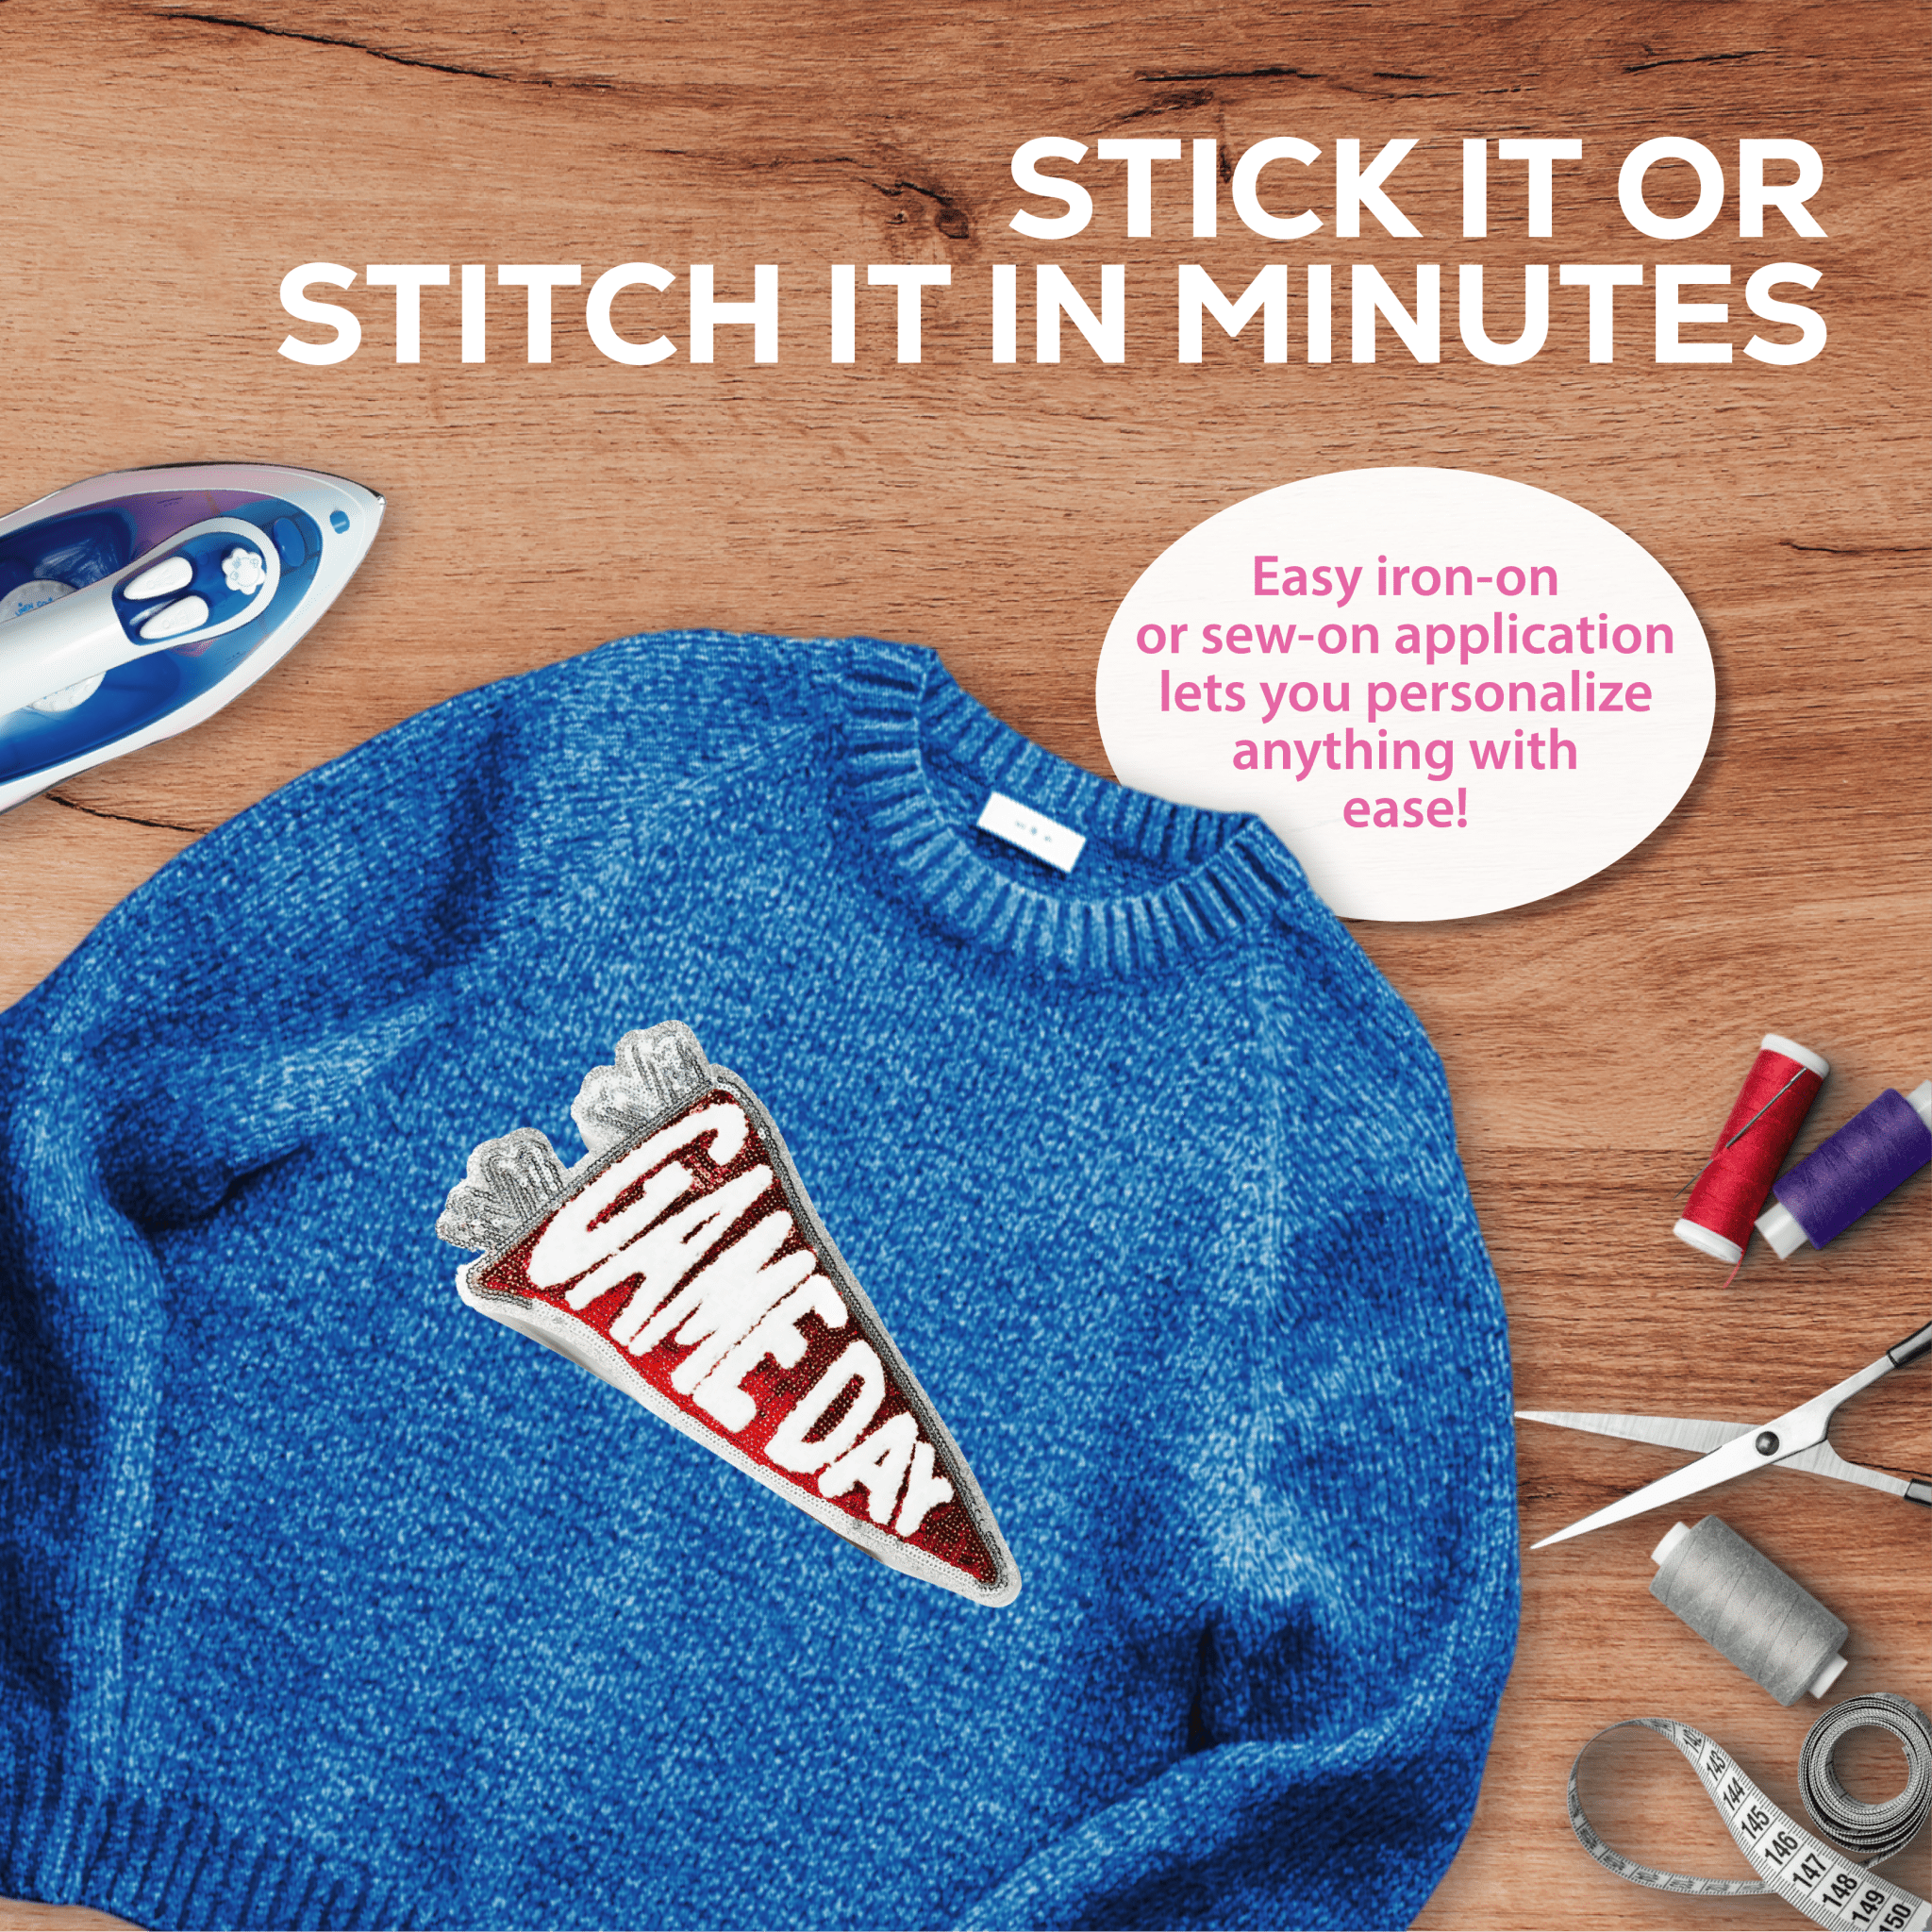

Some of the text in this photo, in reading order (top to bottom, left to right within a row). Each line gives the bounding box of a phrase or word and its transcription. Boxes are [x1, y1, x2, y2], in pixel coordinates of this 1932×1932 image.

[526, 1102, 954, 1538] GAME DAY
[1706, 1750, 1726, 1781] 143
[1723, 1776, 1745, 1811] 144
[1741, 1805, 1770, 1840] 145
[1764, 1831, 1798, 1865] 146
[1792, 1852, 1826, 1888] 147
[1823, 1874, 1857, 1907] 148
[1852, 1890, 1885, 1923] 149
